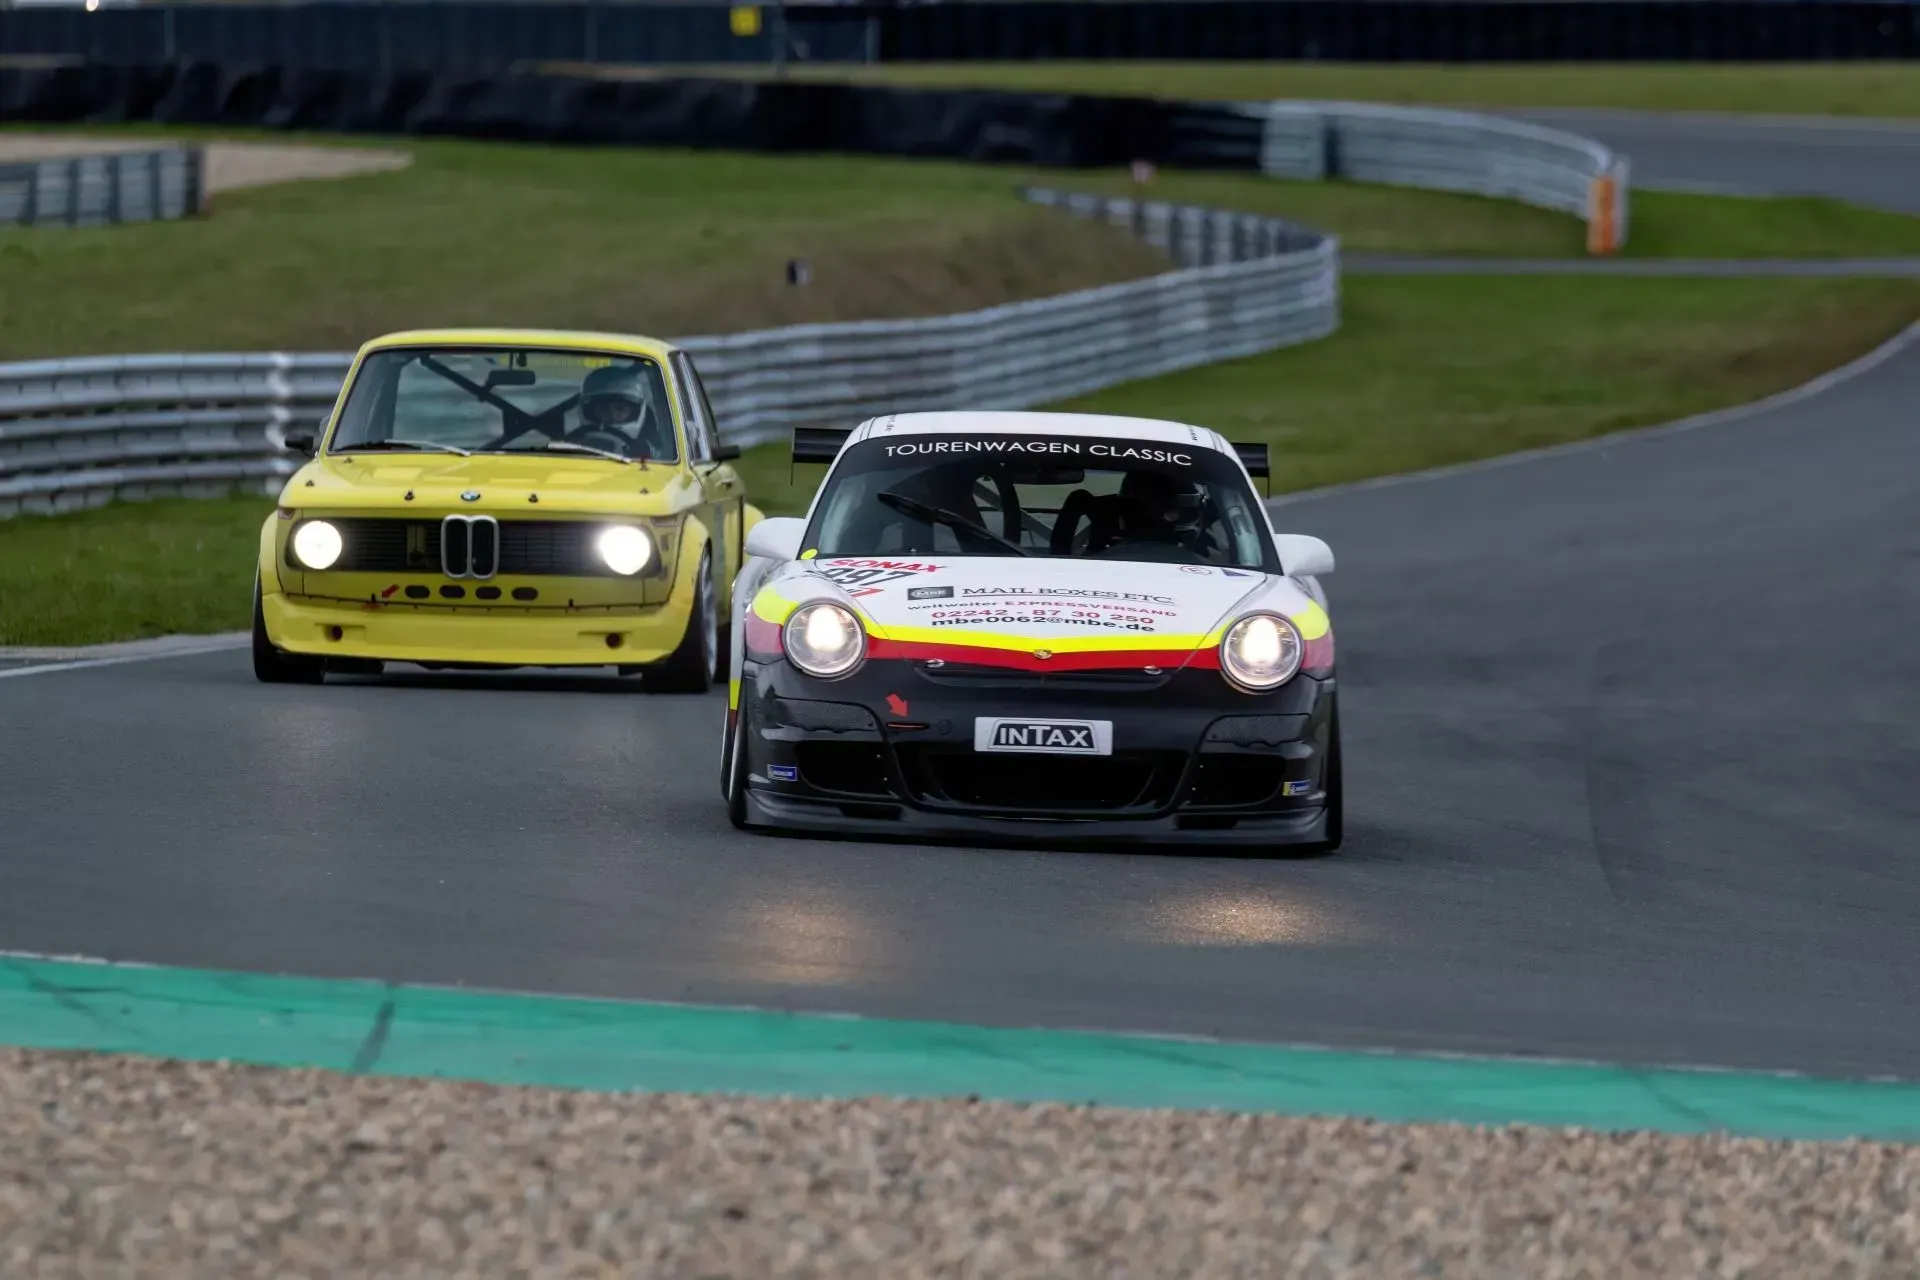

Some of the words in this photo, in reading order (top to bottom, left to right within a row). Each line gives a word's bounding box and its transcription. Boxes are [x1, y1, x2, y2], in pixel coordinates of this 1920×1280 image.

[885, 441, 1080, 457] TOURENWAGEN
[1089, 445, 1192, 466] CLASSIC
[825, 559, 947, 573] SONAX
[962, 587, 1033, 595] MAIL
[1038, 588, 1118, 598] BOXES
[907, 602, 998, 610] weltweiter
[1004, 601, 1176, 617] EXPRESSVERSAND
[931, 609, 1008, 619] 02242
[1071, 610, 1100, 619] 30
[1109, 613, 1154, 624] 250
[931, 616, 1155, 632] mbe0062@mbe.de
[1000, 725, 1089, 747] INTAX
